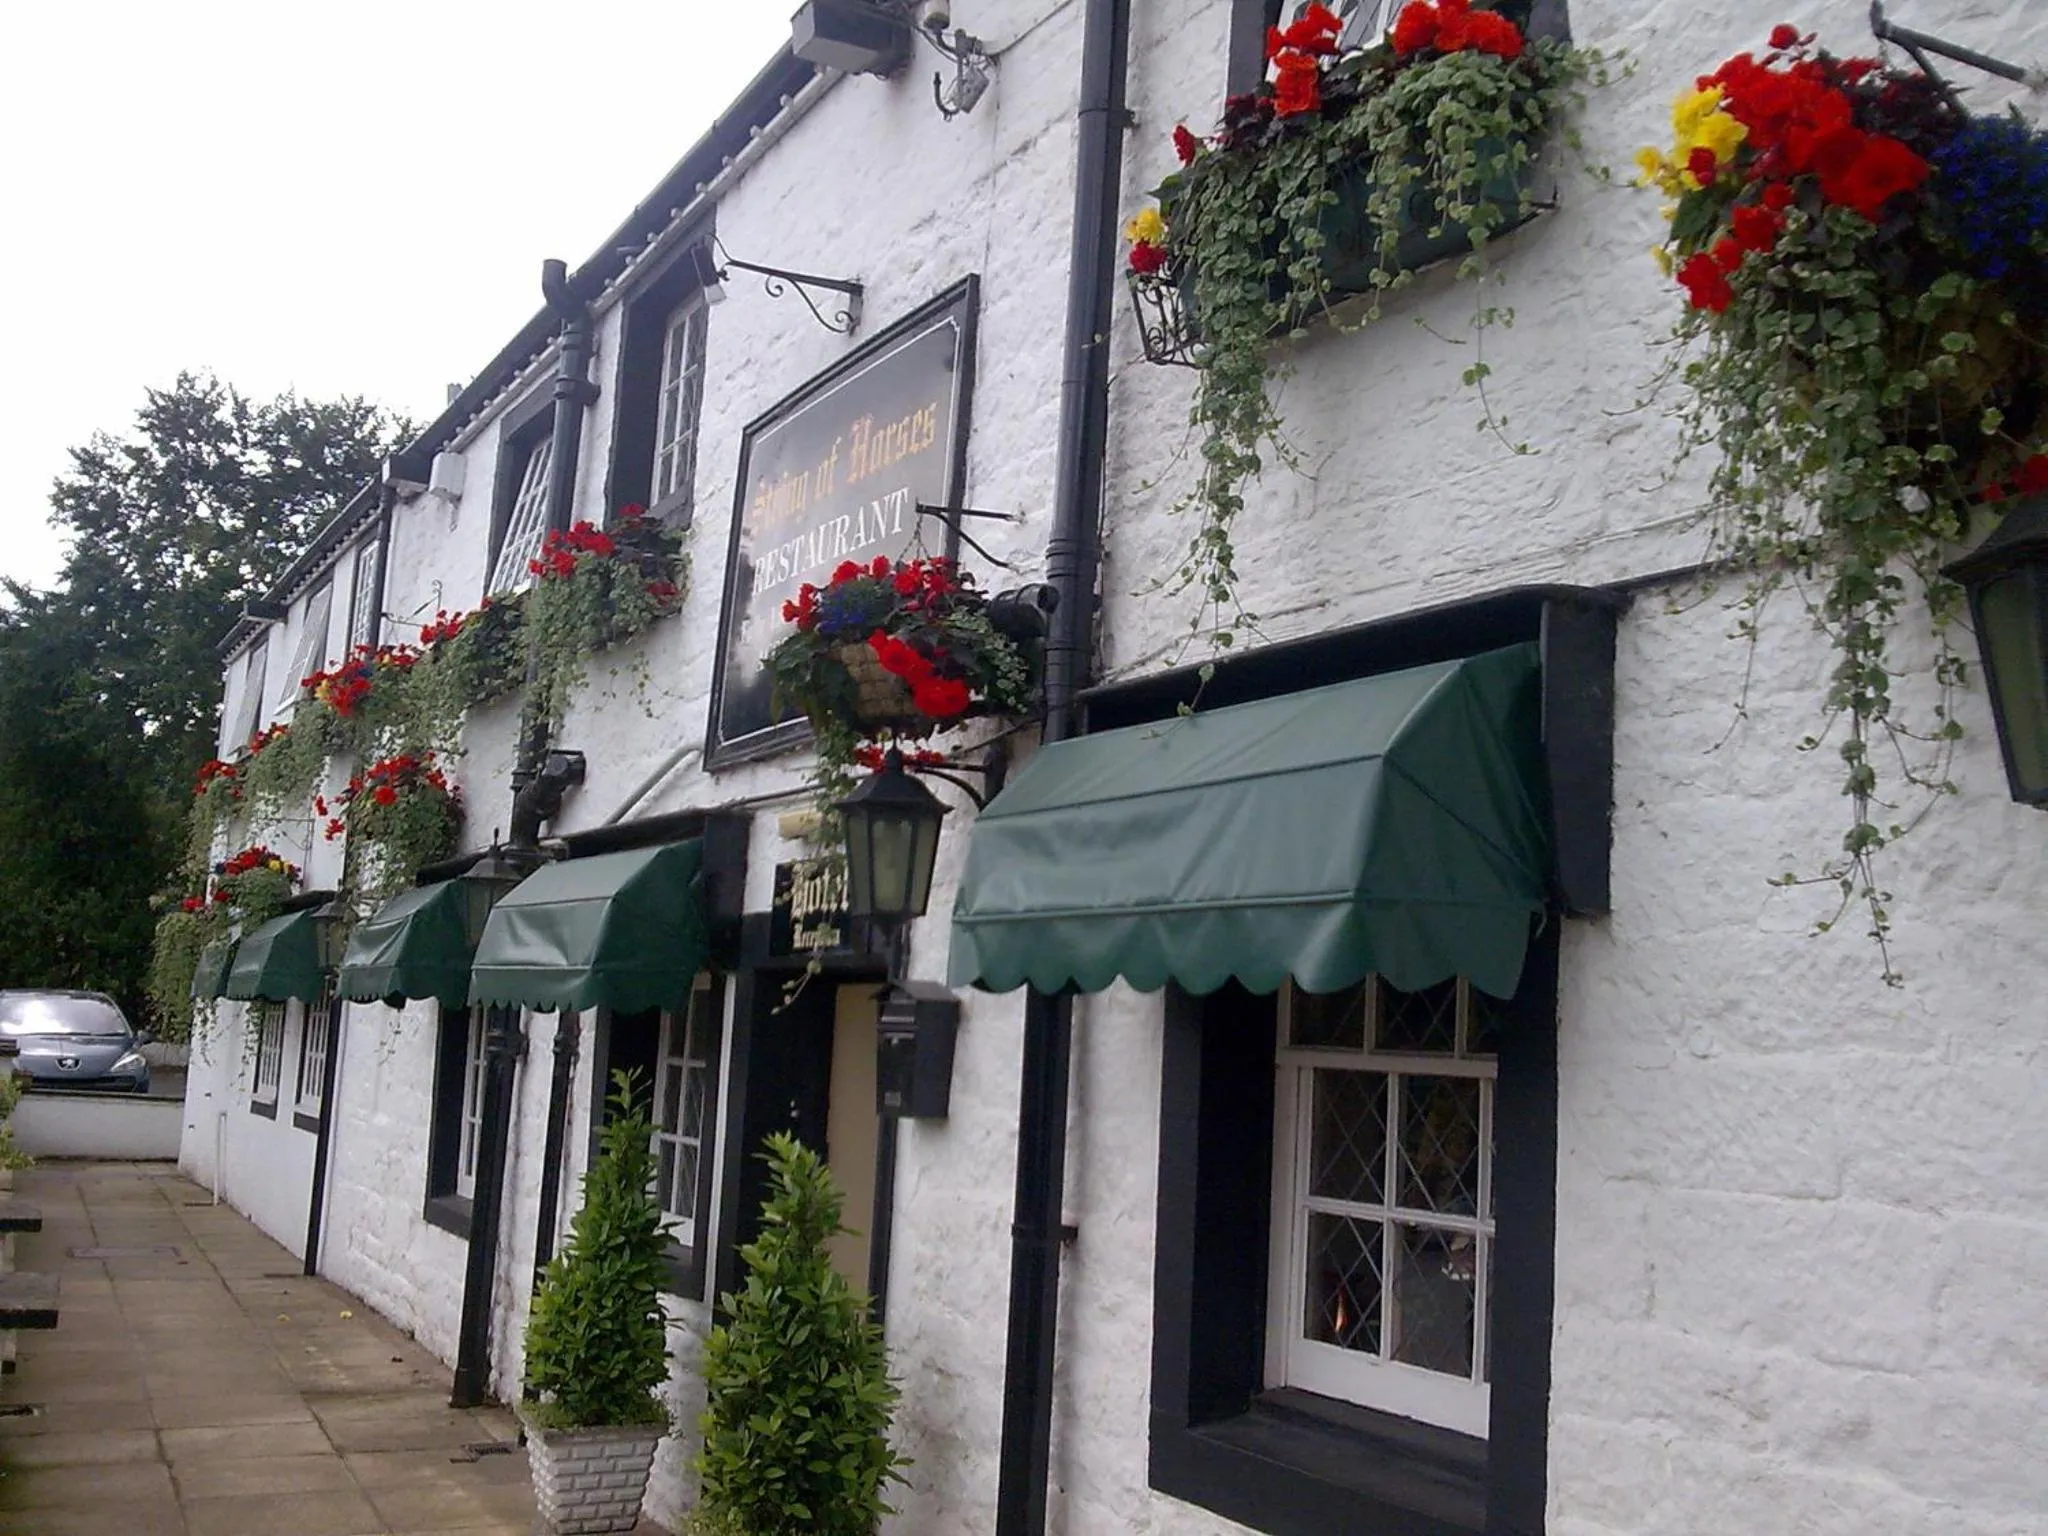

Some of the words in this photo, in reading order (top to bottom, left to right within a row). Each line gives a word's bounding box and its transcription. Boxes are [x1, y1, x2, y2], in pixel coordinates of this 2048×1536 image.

[815, 435, 842, 501] of
[847, 402, 939, 484] Horses
[751, 487, 909, 596] RESTAURANT
